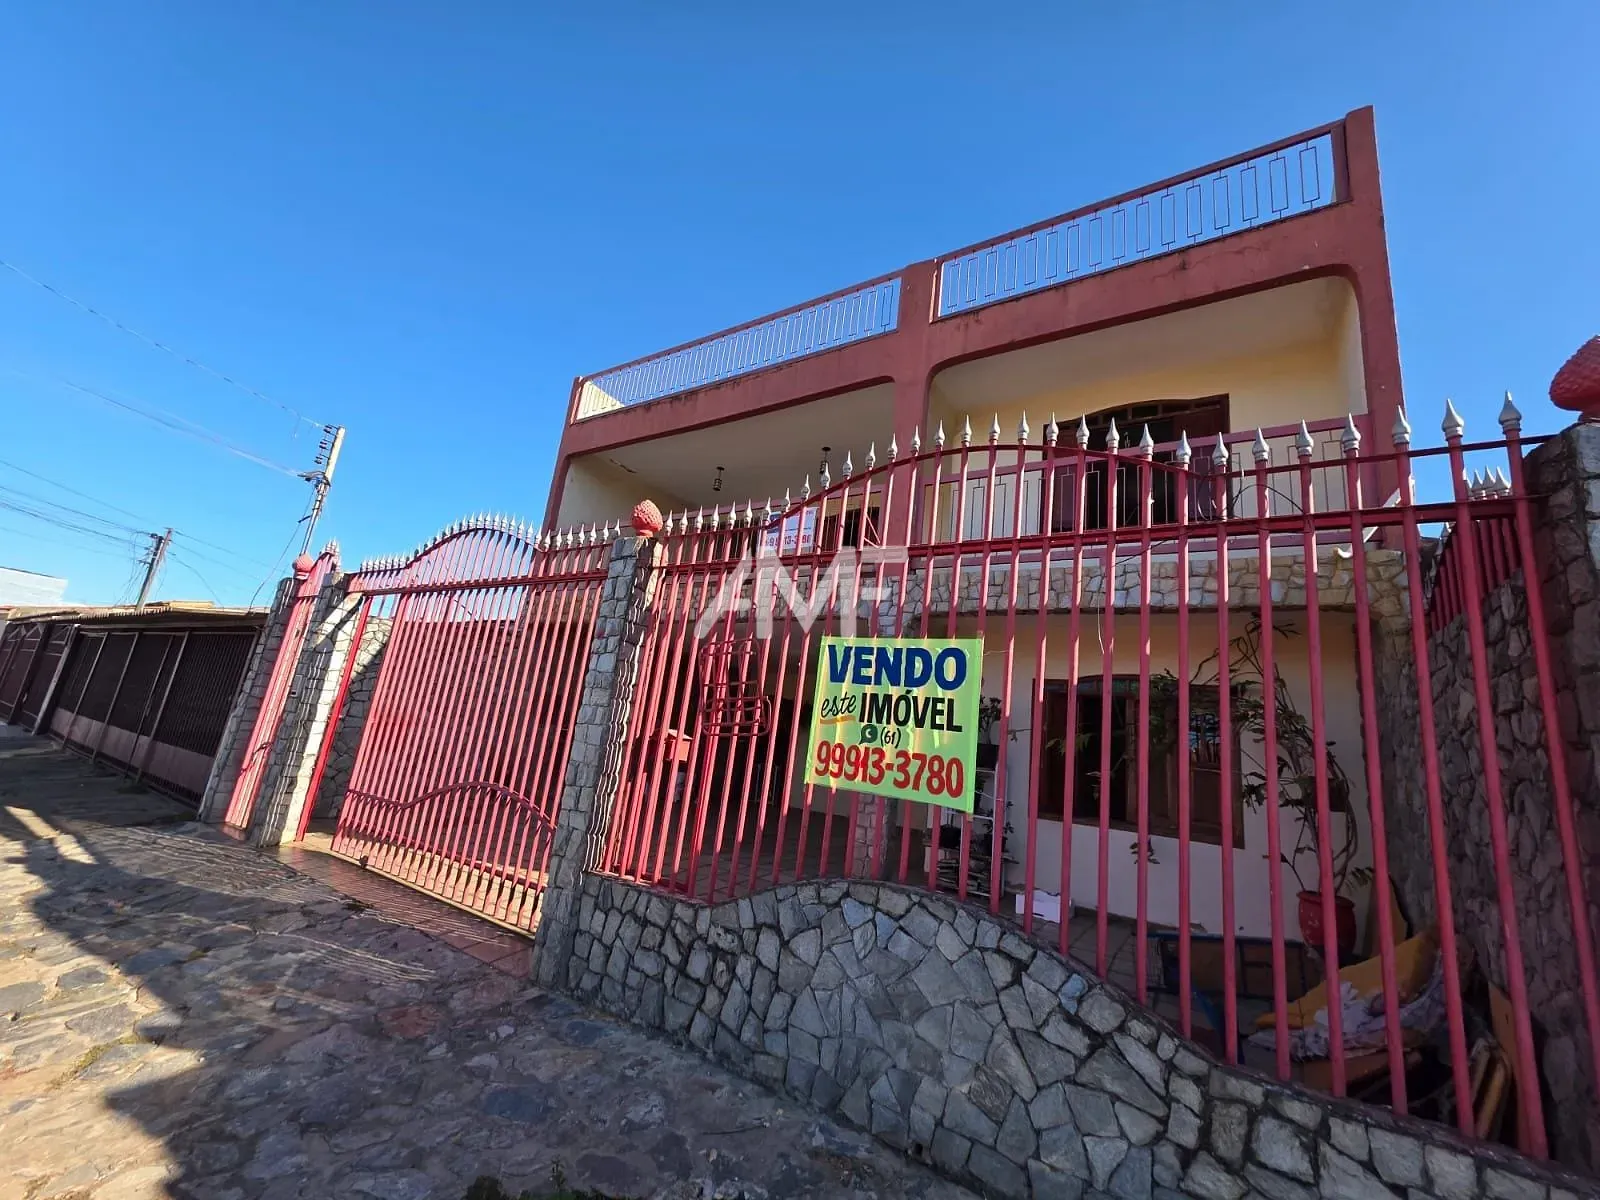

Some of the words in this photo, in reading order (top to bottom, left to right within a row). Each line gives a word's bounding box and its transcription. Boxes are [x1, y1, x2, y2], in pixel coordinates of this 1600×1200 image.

[828, 644, 967, 690] VENDO
[821, 691, 857, 718] este
[859, 690, 963, 732] IMÓVEL
[880, 726, 902, 749] (61)
[815, 740, 964, 798] 99913-3780
